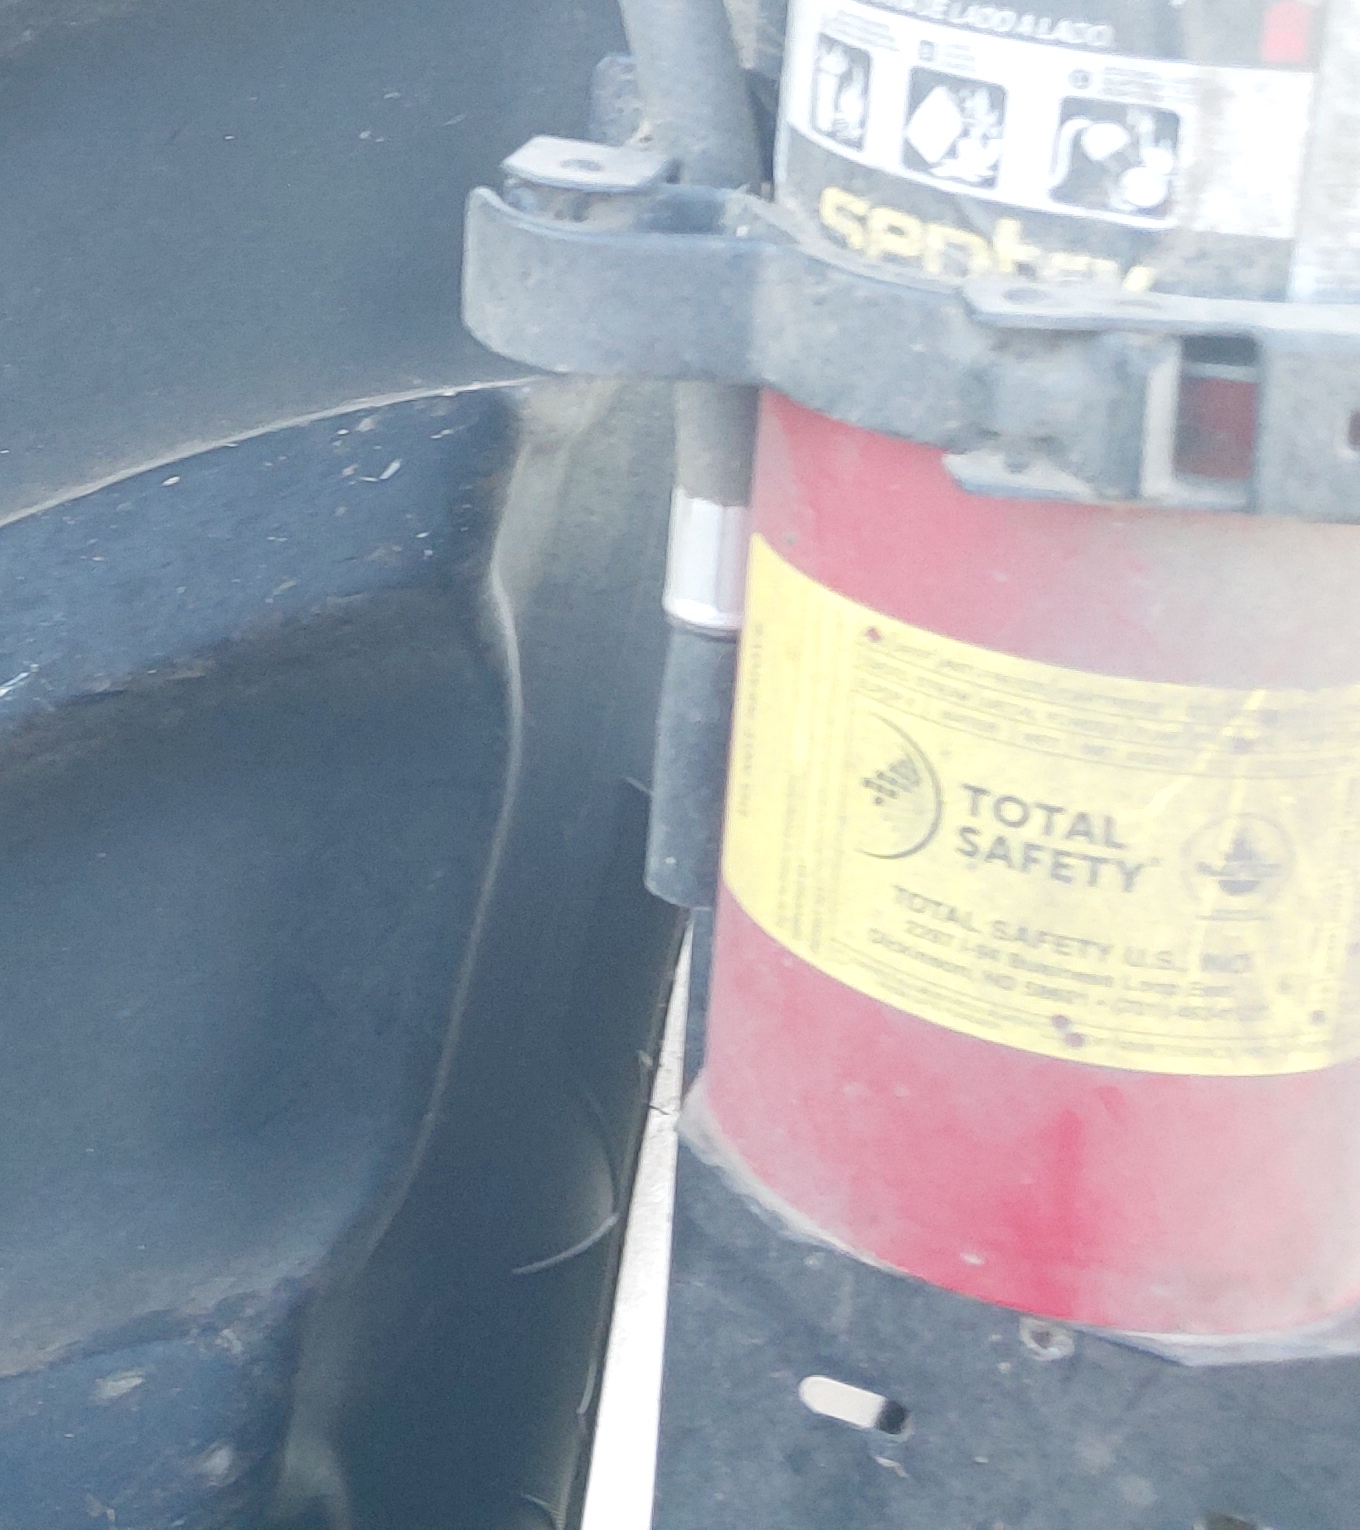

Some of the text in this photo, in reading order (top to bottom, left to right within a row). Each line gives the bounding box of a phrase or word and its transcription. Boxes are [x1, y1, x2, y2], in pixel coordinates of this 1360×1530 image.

[959, 782, 1127, 850] TOTAL
[954, 825, 1150, 895] SAFETY
[892, 885, 982, 933] TOTAL
[991, 920, 1114, 962] SAFETY
